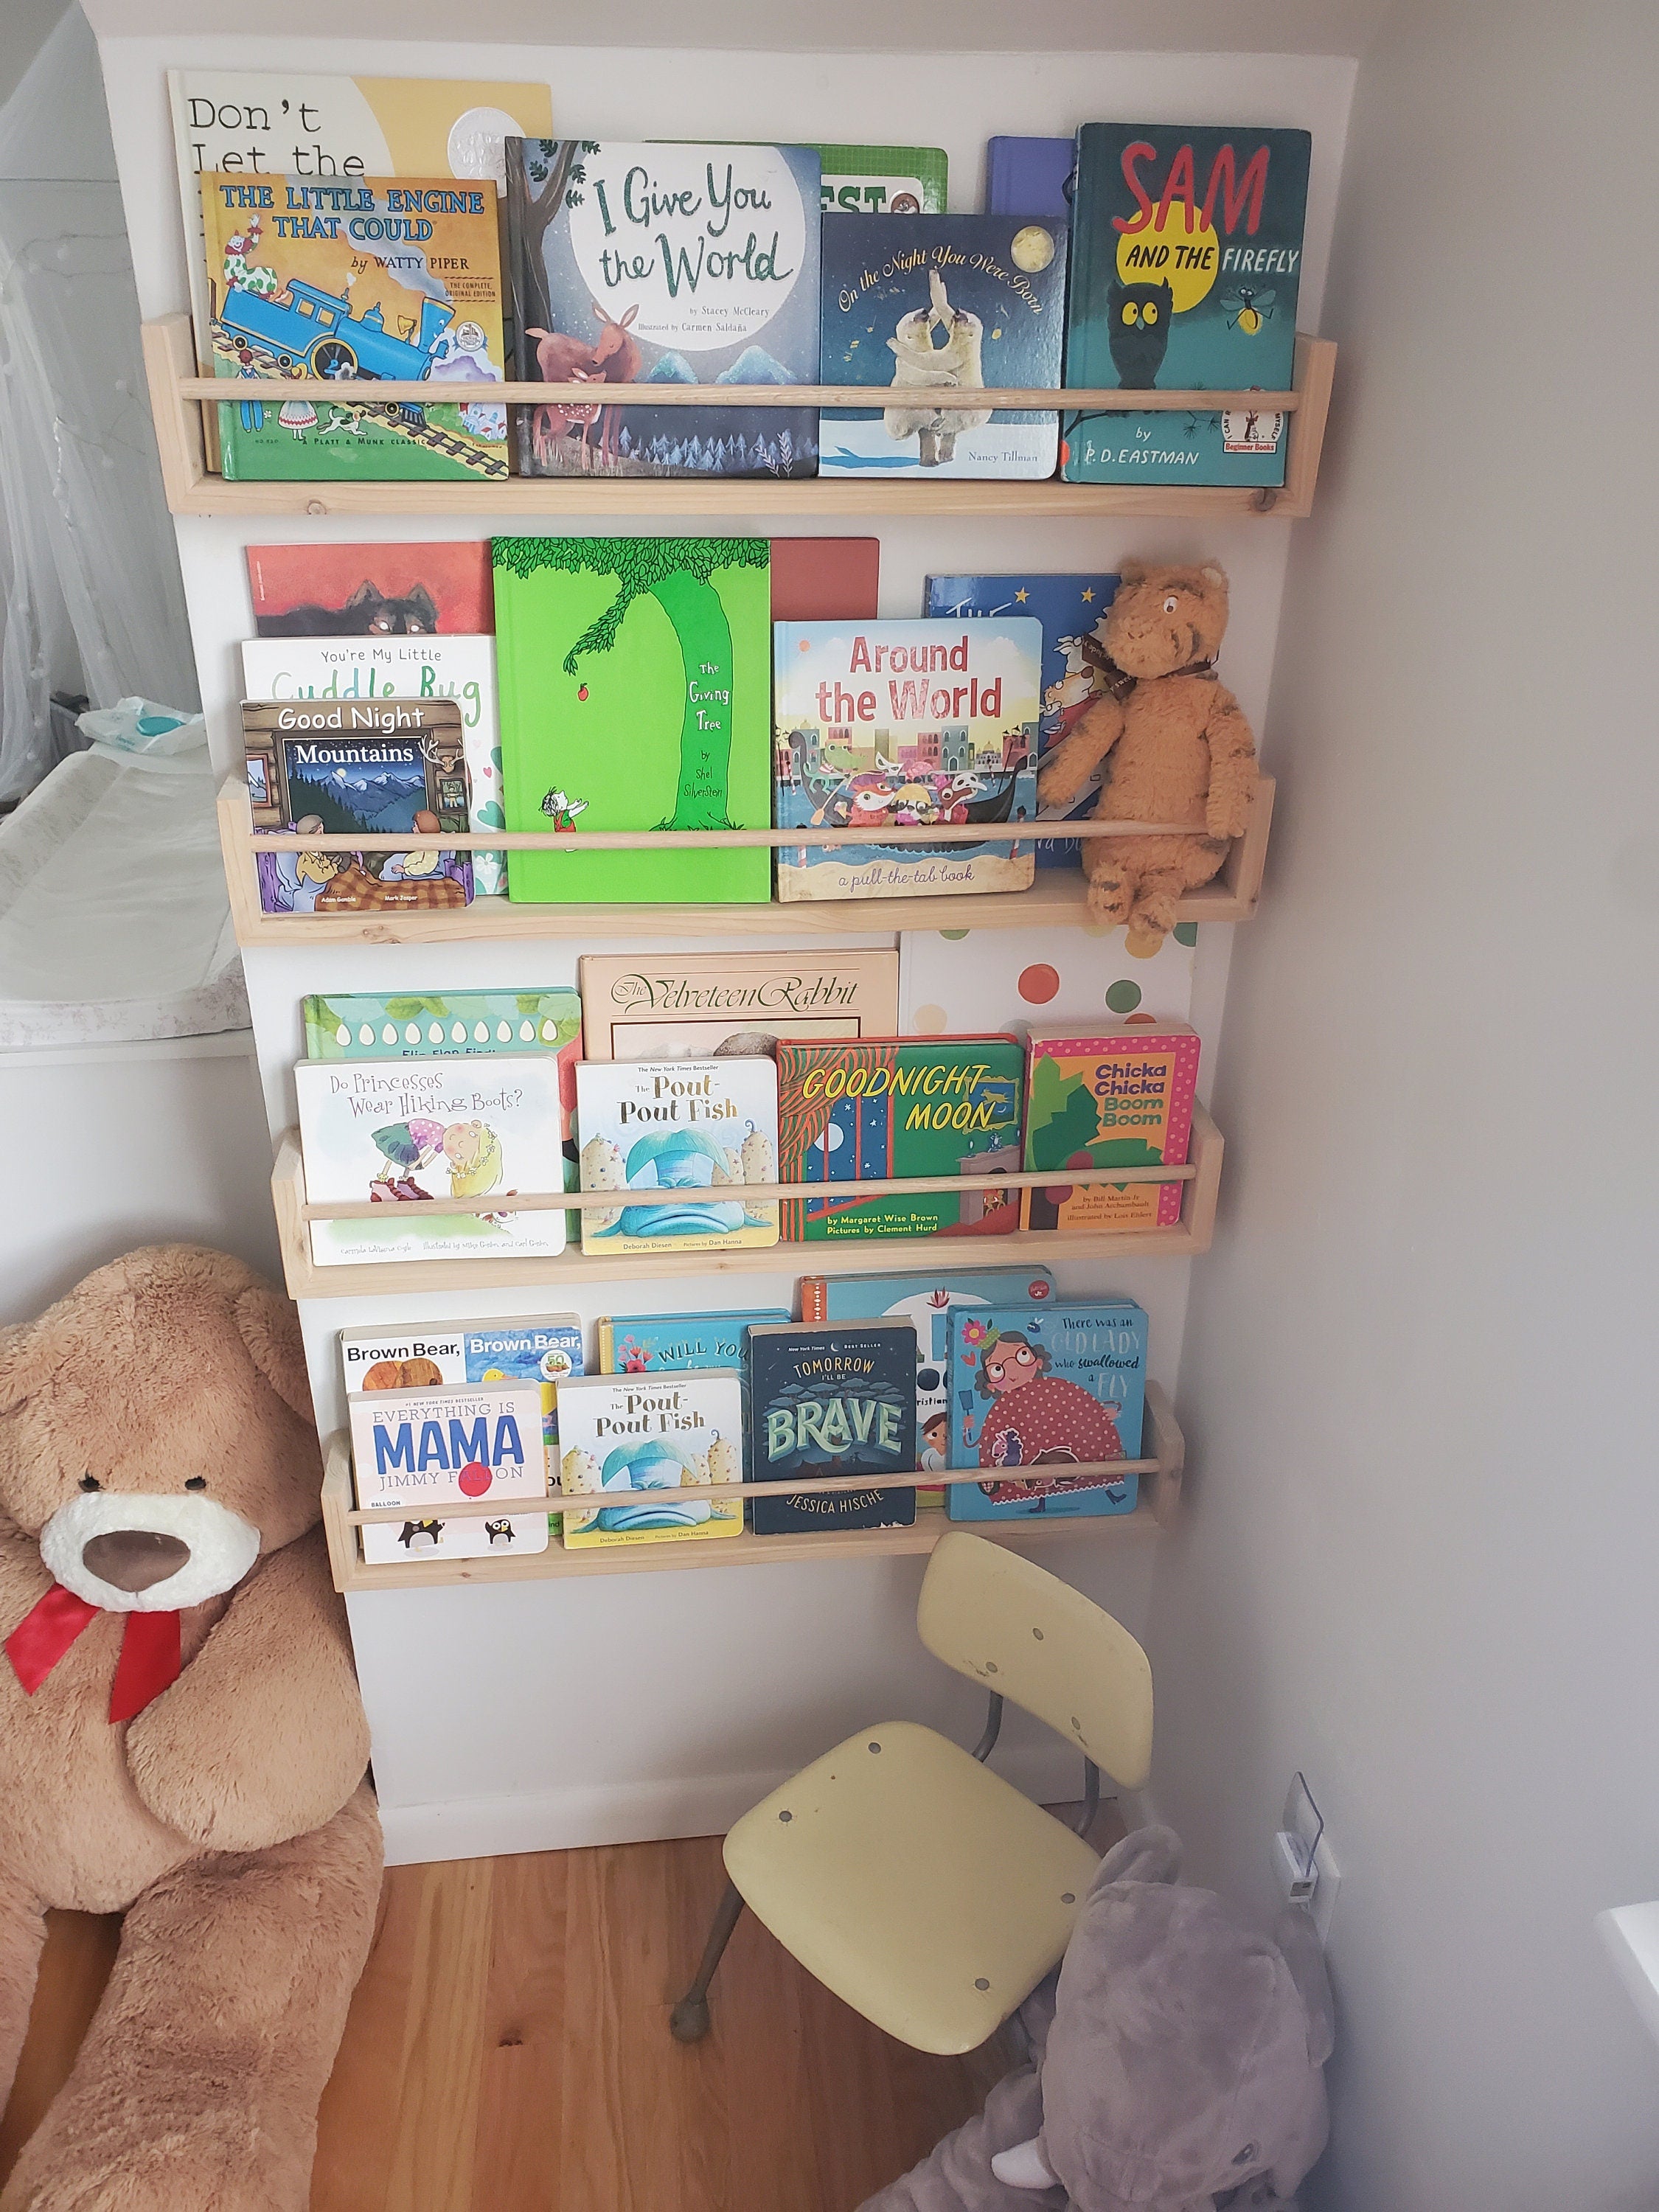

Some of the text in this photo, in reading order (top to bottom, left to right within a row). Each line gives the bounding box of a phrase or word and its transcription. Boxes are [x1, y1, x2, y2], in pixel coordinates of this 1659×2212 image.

[187, 97, 321, 132] Don't
[192, 144, 366, 177] Let the
[219, 184, 484, 215] THE LITTLE ENGINE
[593, 162, 772, 237] I Give You
[1112, 141, 1270, 235] SAM
[272, 216, 434, 241] THAT COULD
[350, 257, 470, 274] by WATTY PIPER
[599, 231, 794, 298] the World
[1125, 244, 1300, 273] AND THE FIREFLY
[838, 246, 1043, 315] On the Night You Were Born
[689, 305, 769, 318] by Stacey McCleary
[638, 323, 669, 331] Illustrated
[671, 323, 678, 332] by
[681, 322, 712, 331] Carmen
[1135, 426, 1152, 442] by
[1271, 413, 1281, 440] MYSELF
[968, 451, 1038, 465] Nancy Tillman
[1118, 448, 1200, 465] EASTMAN
[1225, 443, 1253, 451] Beginner
[321, 648, 442, 664] You're My Little
[849, 635, 969, 674] Around
[700, 663, 720, 675] The
[271, 665, 481, 728] Cuddle Bug
[815, 677, 1002, 723] the World
[278, 705, 425, 734] Good Night
[695, 710, 722, 731] Tree
[296, 744, 414, 765] Mountains
[701, 750, 710, 762] by
[838, 863, 975, 893] a pull-the-tab book
[615, 975, 859, 1012] The Velveteen Rabbit
[802, 1064, 991, 1099] GOODNIGHT
[1095, 1062, 1166, 1079] Chicka
[330, 1072, 443, 1093] Do Princesses
[650, 1074, 720, 1099] Pout-
[1094, 1080, 1165, 1096] Chicka
[347, 1088, 523, 1119] Wear Hiking Boots?
[617, 1098, 738, 1124] Pout Fish
[1104, 1096, 1164, 1111] Boom
[905, 1101, 996, 1130] MOON
[1102, 1112, 1162, 1127] Boom
[827, 1213, 938, 1225] by Margaret Wise Brown
[827, 1223, 937, 1234] Pictures by Clement Hurd
[623, 1242, 650, 1250] Deborah
[1062, 1318, 1133, 1329] There was an
[347, 1342, 460, 1362] Brown Bear,
[470, 1334, 581, 1354] Brown Bear,
[658, 1341, 748, 1363] WILL YOU
[1051, 1329, 1142, 1354] OLD LADY
[793, 1357, 874, 1378] TOMORROW
[1055, 1354, 1139, 1369] who swallowed
[1088, 1373, 1131, 1397] a FLY
[372, 1402, 515, 1423] EVERYTHING IS
[624, 1391, 688, 1414] Pout-
[917, 1397, 947, 1406] ristian
[593, 1411, 706, 1437] Pout Fish
[767, 1397, 903, 1463] BRAVE
[373, 1414, 525, 1475] MAMA
[380, 1466, 524, 1492] JIMMY FALLON
[786, 1489, 884, 1513] JESSICA HISCHE
